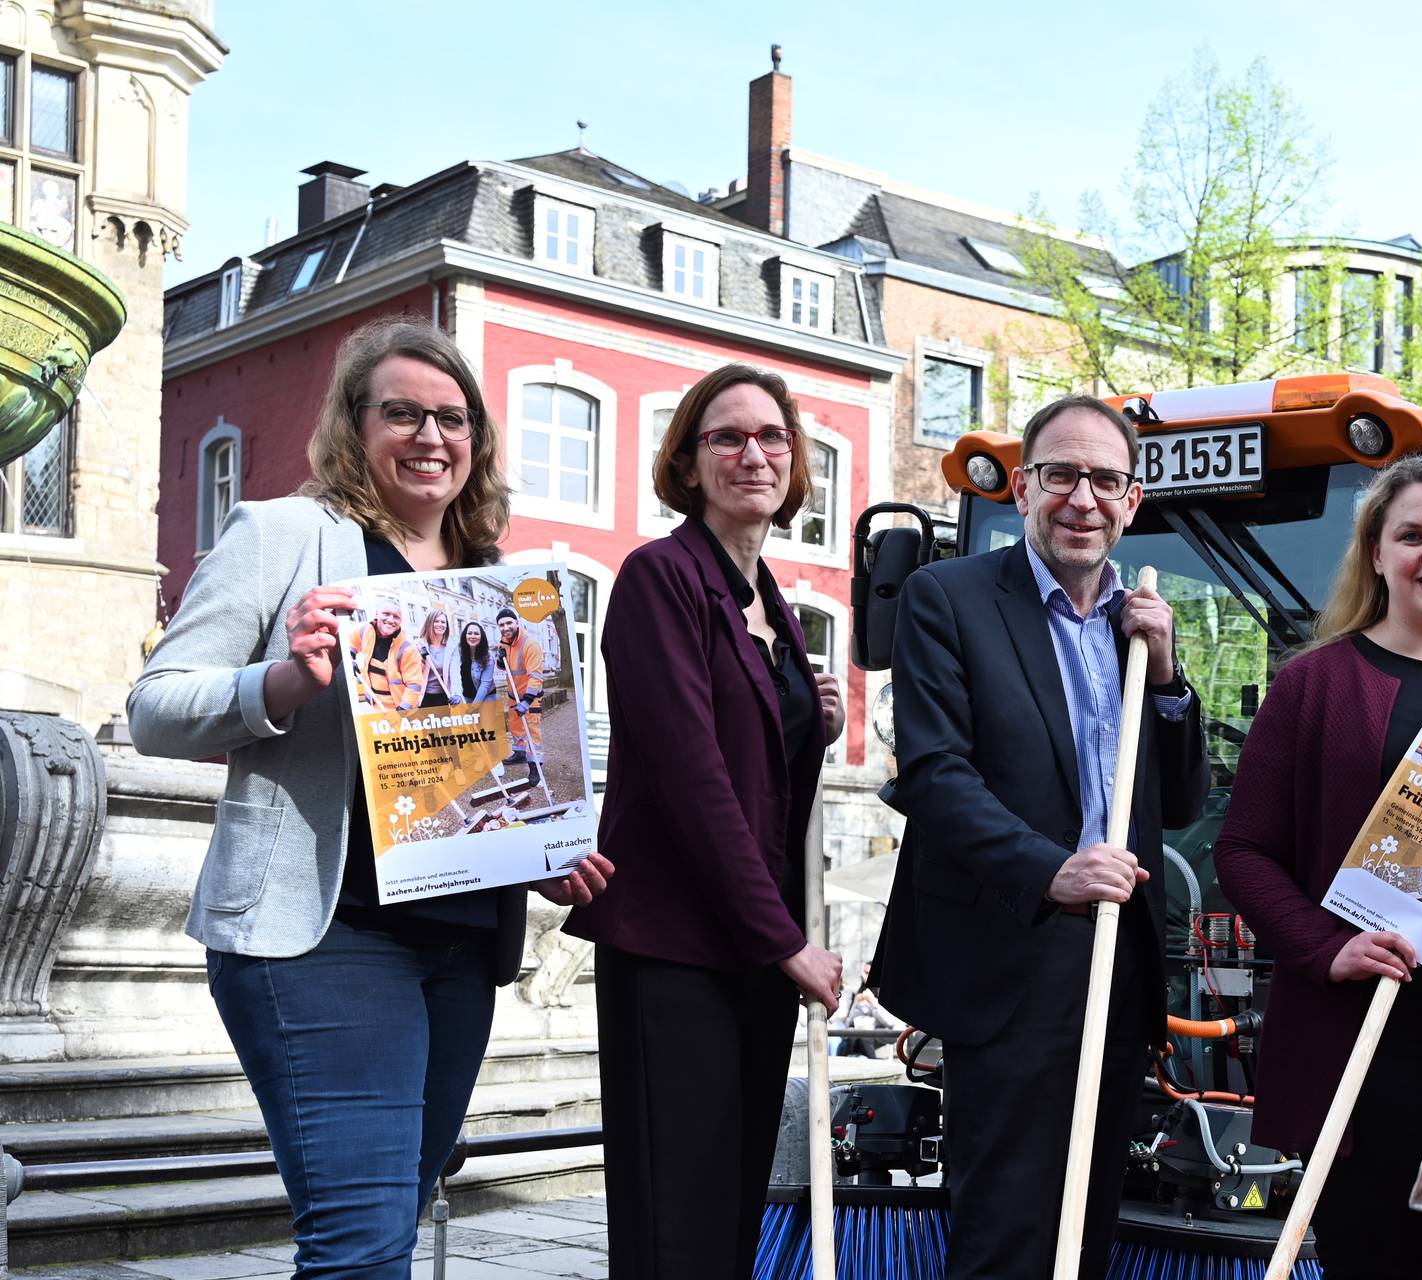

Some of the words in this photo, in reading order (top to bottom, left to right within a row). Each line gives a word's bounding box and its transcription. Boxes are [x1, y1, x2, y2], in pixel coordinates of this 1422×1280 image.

[1184, 486, 1218, 494] kommunale
[1220, 484, 1252, 492] Maschinen
[370, 719, 396, 735] 10.
[400, 712, 480, 732] Aachener
[374, 728, 496, 754] Frühjahrsputz
[378, 762, 418, 770] Gemeinsam
[420, 756, 452, 766] anpacken
[392, 771, 414, 779] unsere
[416, 767, 438, 776] Stadt!
[409, 778, 426, 788] April
[1386, 809, 1395, 818] für
[1395, 816, 1415, 829] unsere
[1404, 828, 1419, 841] April
[544, 840, 564, 850] stadt
[564, 838, 592, 847] aachen
[386, 877, 481, 896] aachen.de/fruehjahrsputz
[1330, 898, 1386, 932] aachen.de/fruehjah
